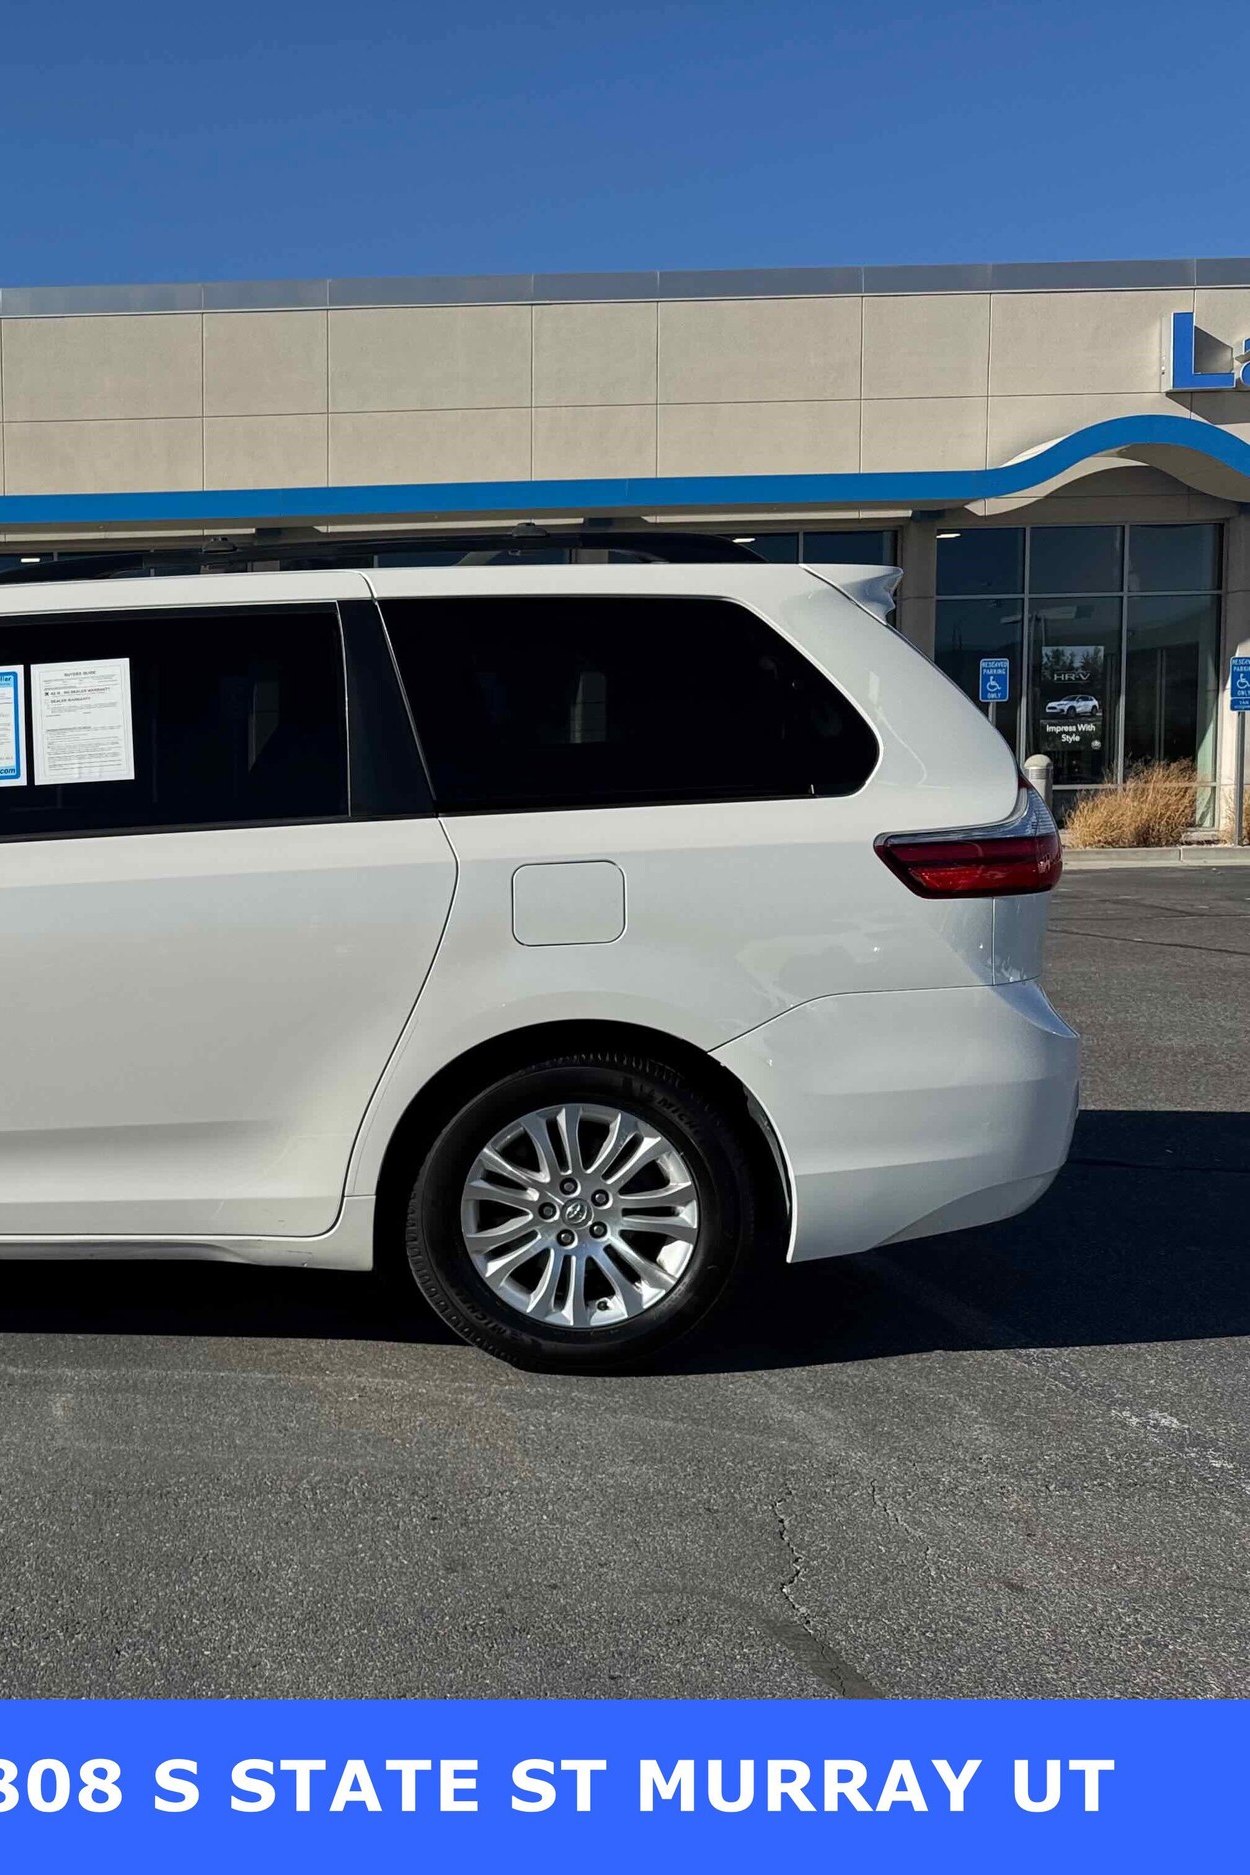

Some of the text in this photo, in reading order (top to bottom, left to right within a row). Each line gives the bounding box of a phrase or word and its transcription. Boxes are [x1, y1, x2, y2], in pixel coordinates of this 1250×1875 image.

[1171, 311, 1250, 390] L
[1046, 723, 1096, 734] Impress With
[1061, 733, 1081, 744] Style
